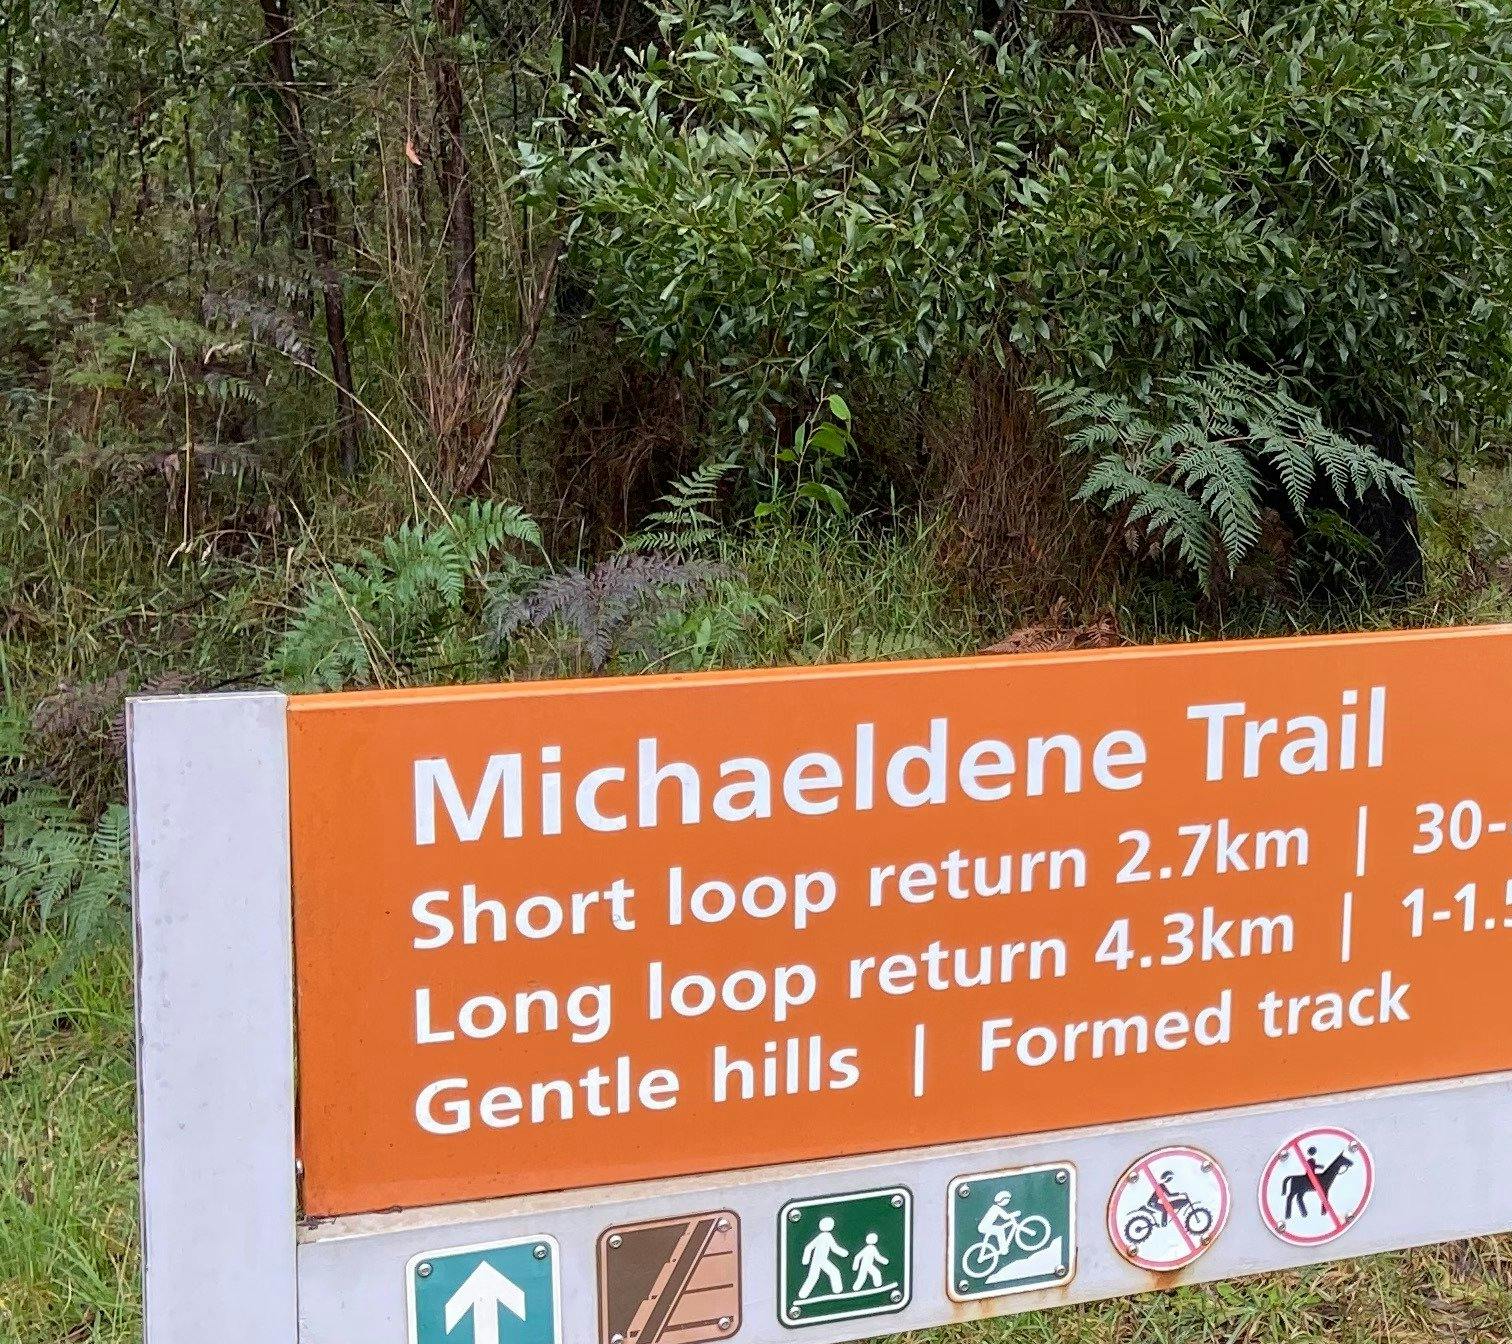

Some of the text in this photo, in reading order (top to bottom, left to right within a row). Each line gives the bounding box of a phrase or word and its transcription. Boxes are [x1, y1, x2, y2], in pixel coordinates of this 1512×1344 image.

[410, 684, 1389, 849] Michaeldene Trail
[410, 876, 638, 952] Short
[667, 864, 840, 931] loop
[868, 845, 1089, 909] return
[1114, 817, 1311, 885] 2.7km
[412, 982, 614, 1047] Long
[647, 959, 820, 1025] loop
[847, 935, 1069, 1001] return
[1094, 904, 1296, 972] 4.3km
[412, 1054, 682, 1136] Gentle
[711, 1033, 862, 1105] hills
[979, 987, 1234, 1074] Formed
[1257, 969, 1412, 1040] track
